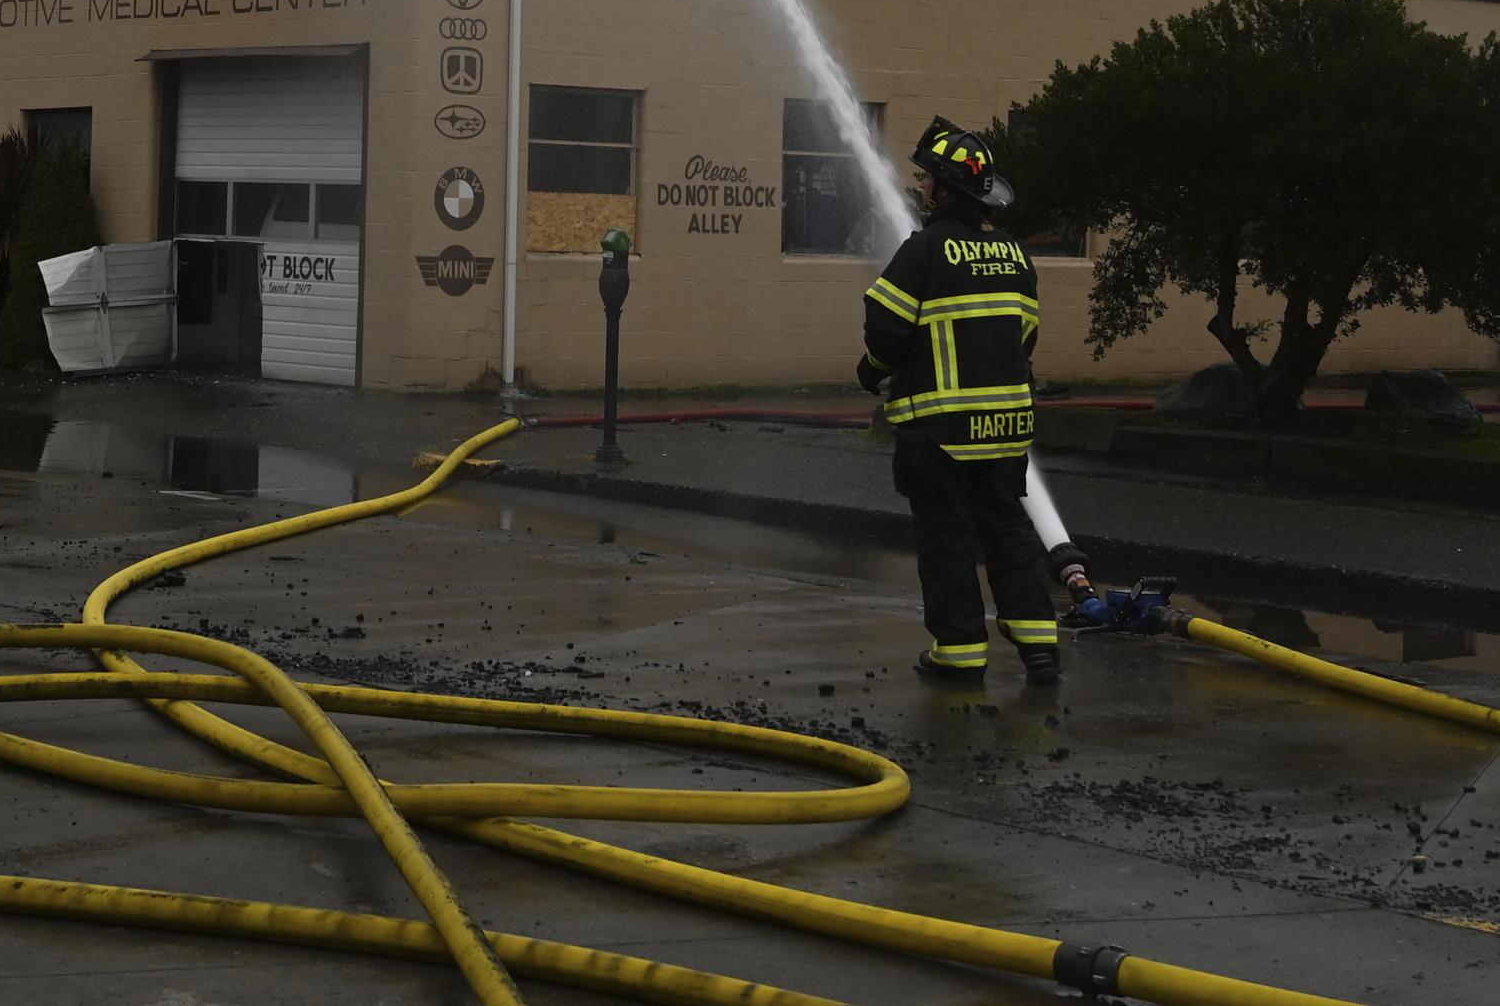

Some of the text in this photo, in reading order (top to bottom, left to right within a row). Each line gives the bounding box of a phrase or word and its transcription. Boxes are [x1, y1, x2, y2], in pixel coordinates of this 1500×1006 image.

[438, 167, 484, 194] BMW
[657, 184, 776, 208] DO NOT BLOCK
[687, 213, 743, 234] ALLEY
[944, 237, 1029, 271] OLYMPIA
[283, 256, 336, 282] BLOCK
[437, 259, 475, 280] MINI
[294, 283, 312, 295] 24/7
[969, 409, 1035, 440] HARTER
